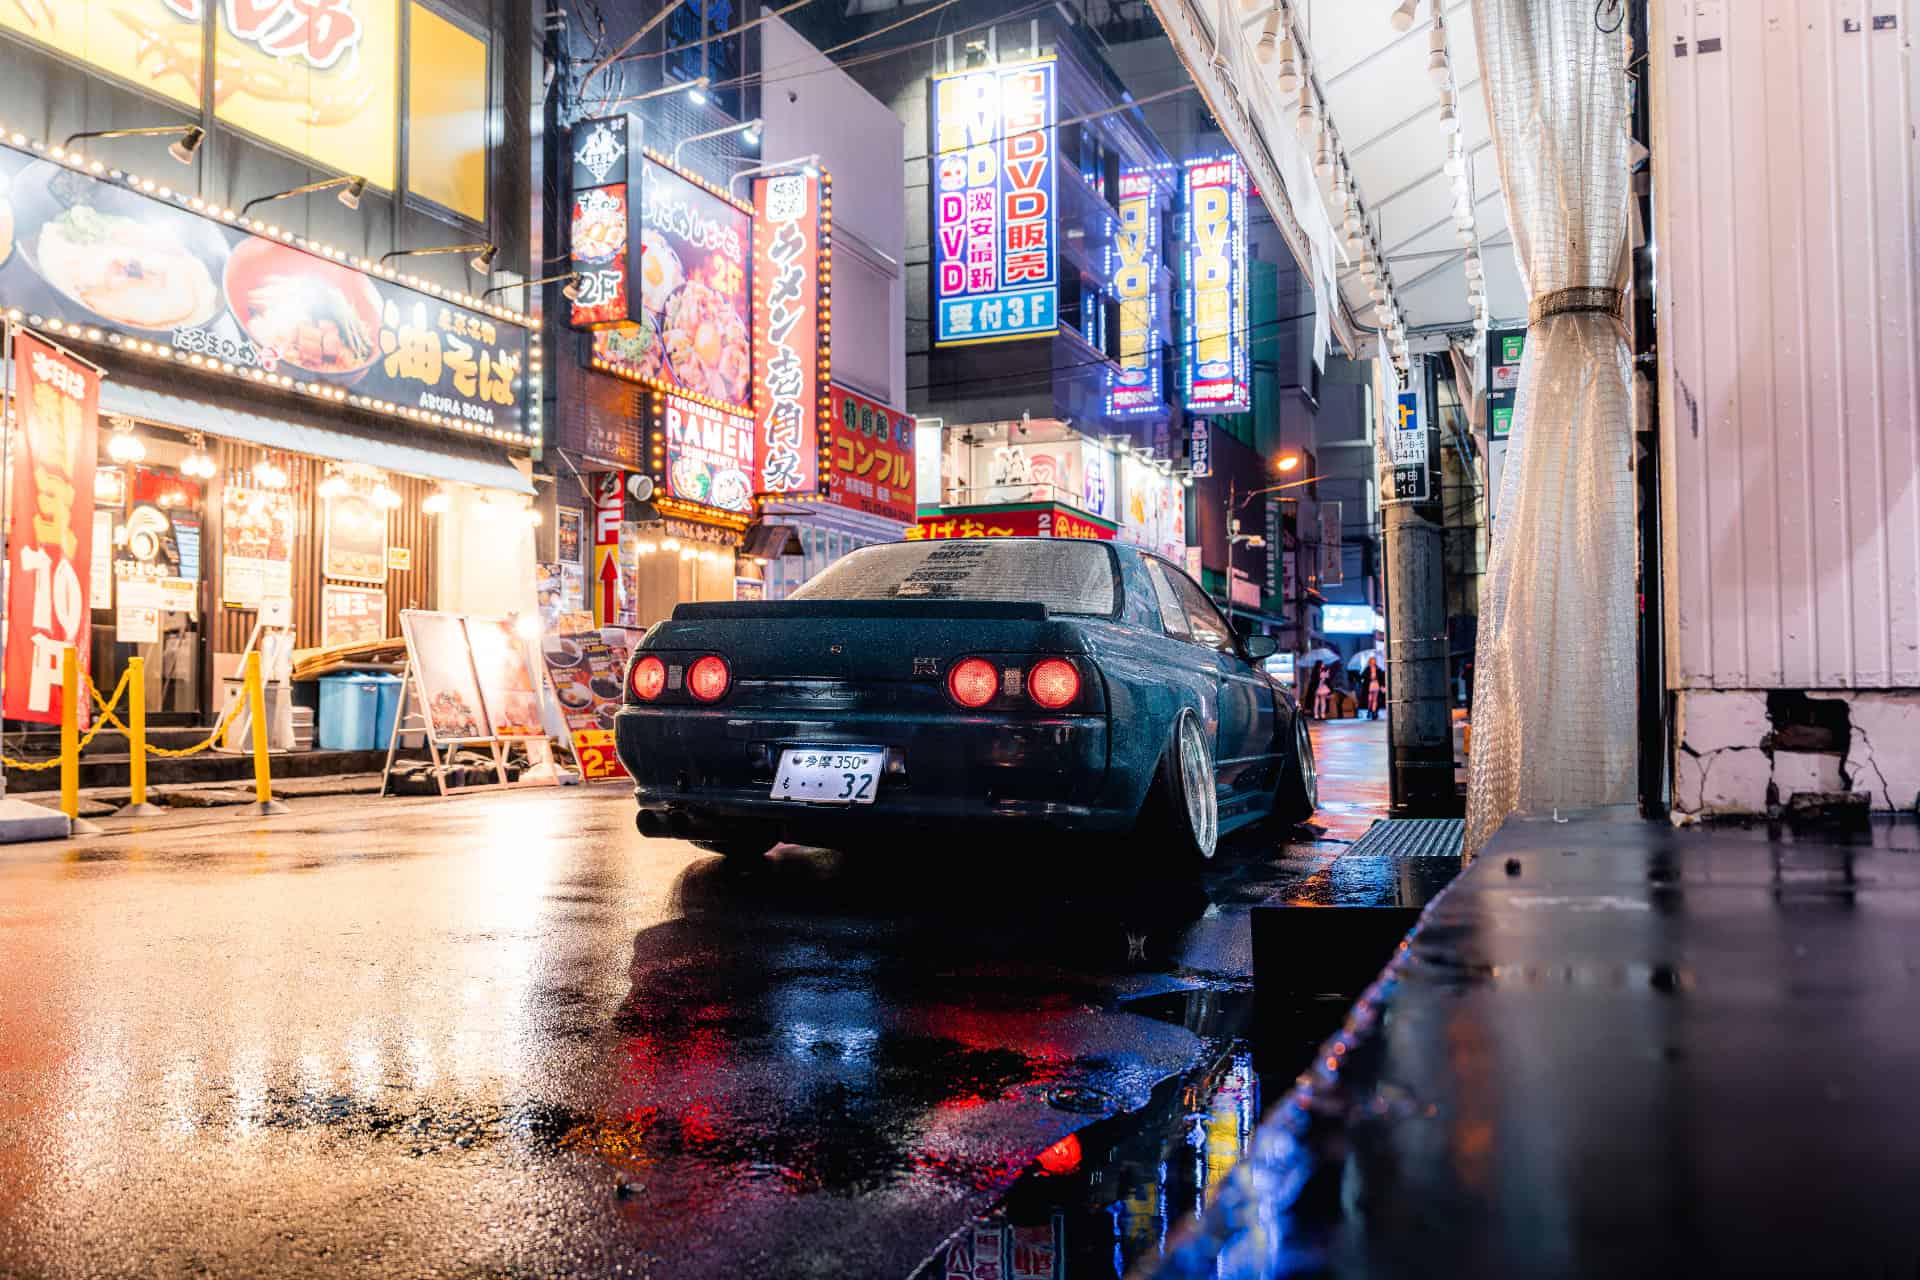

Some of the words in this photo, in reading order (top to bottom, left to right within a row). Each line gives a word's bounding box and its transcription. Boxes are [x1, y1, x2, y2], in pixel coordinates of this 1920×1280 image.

[1005, 71, 1046, 282] DVD販売
[940, 192, 967, 297] DVD
[577, 271, 622, 306] 2F
[380, 300, 522, 406] 油そば
[419, 391, 461, 416] ABURA
[462, 402, 495, 424] SOBA
[667, 408, 754, 462] RAMEN
[582, 748, 616, 777] 2F
[834, 755, 861, 769] 350
[838, 773, 873, 799] 32
